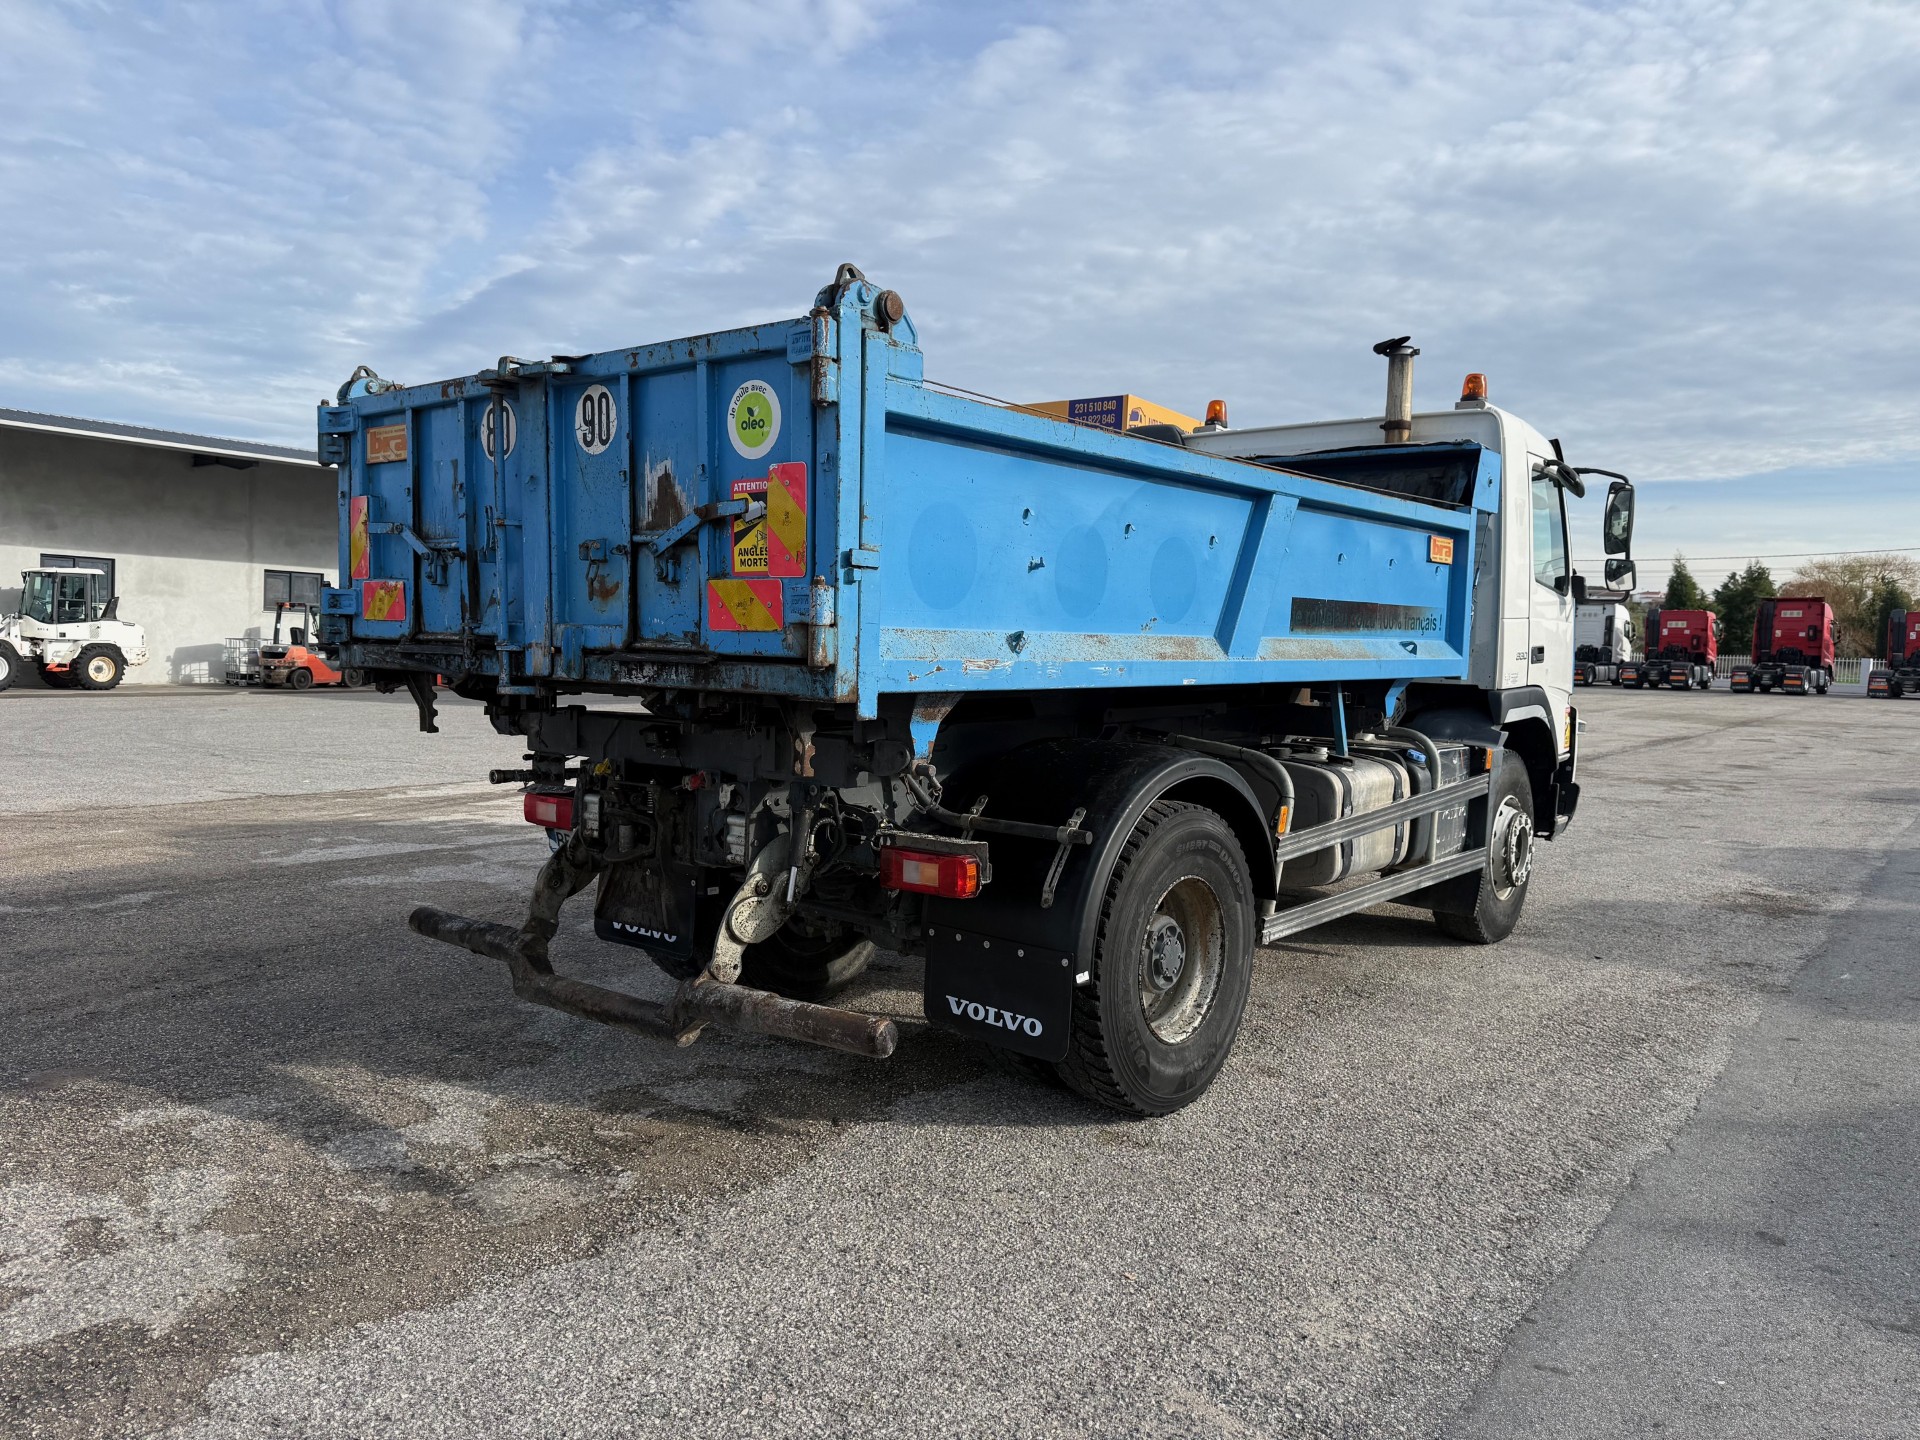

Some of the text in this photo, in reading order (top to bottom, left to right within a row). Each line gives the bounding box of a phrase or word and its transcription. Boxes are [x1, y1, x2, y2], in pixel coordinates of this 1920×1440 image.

[729, 384, 767, 419] Je roule avec
[1075, 400, 1116, 413] 231 510 840
[582, 391, 610, 447] 90
[1102, 414, 1115, 424] 846
[733, 481, 768, 491] ATTENTIO
[740, 558, 768, 567] MORTS
[1404, 611, 1437, 636] français
[945, 994, 1043, 1037] VOLVO
